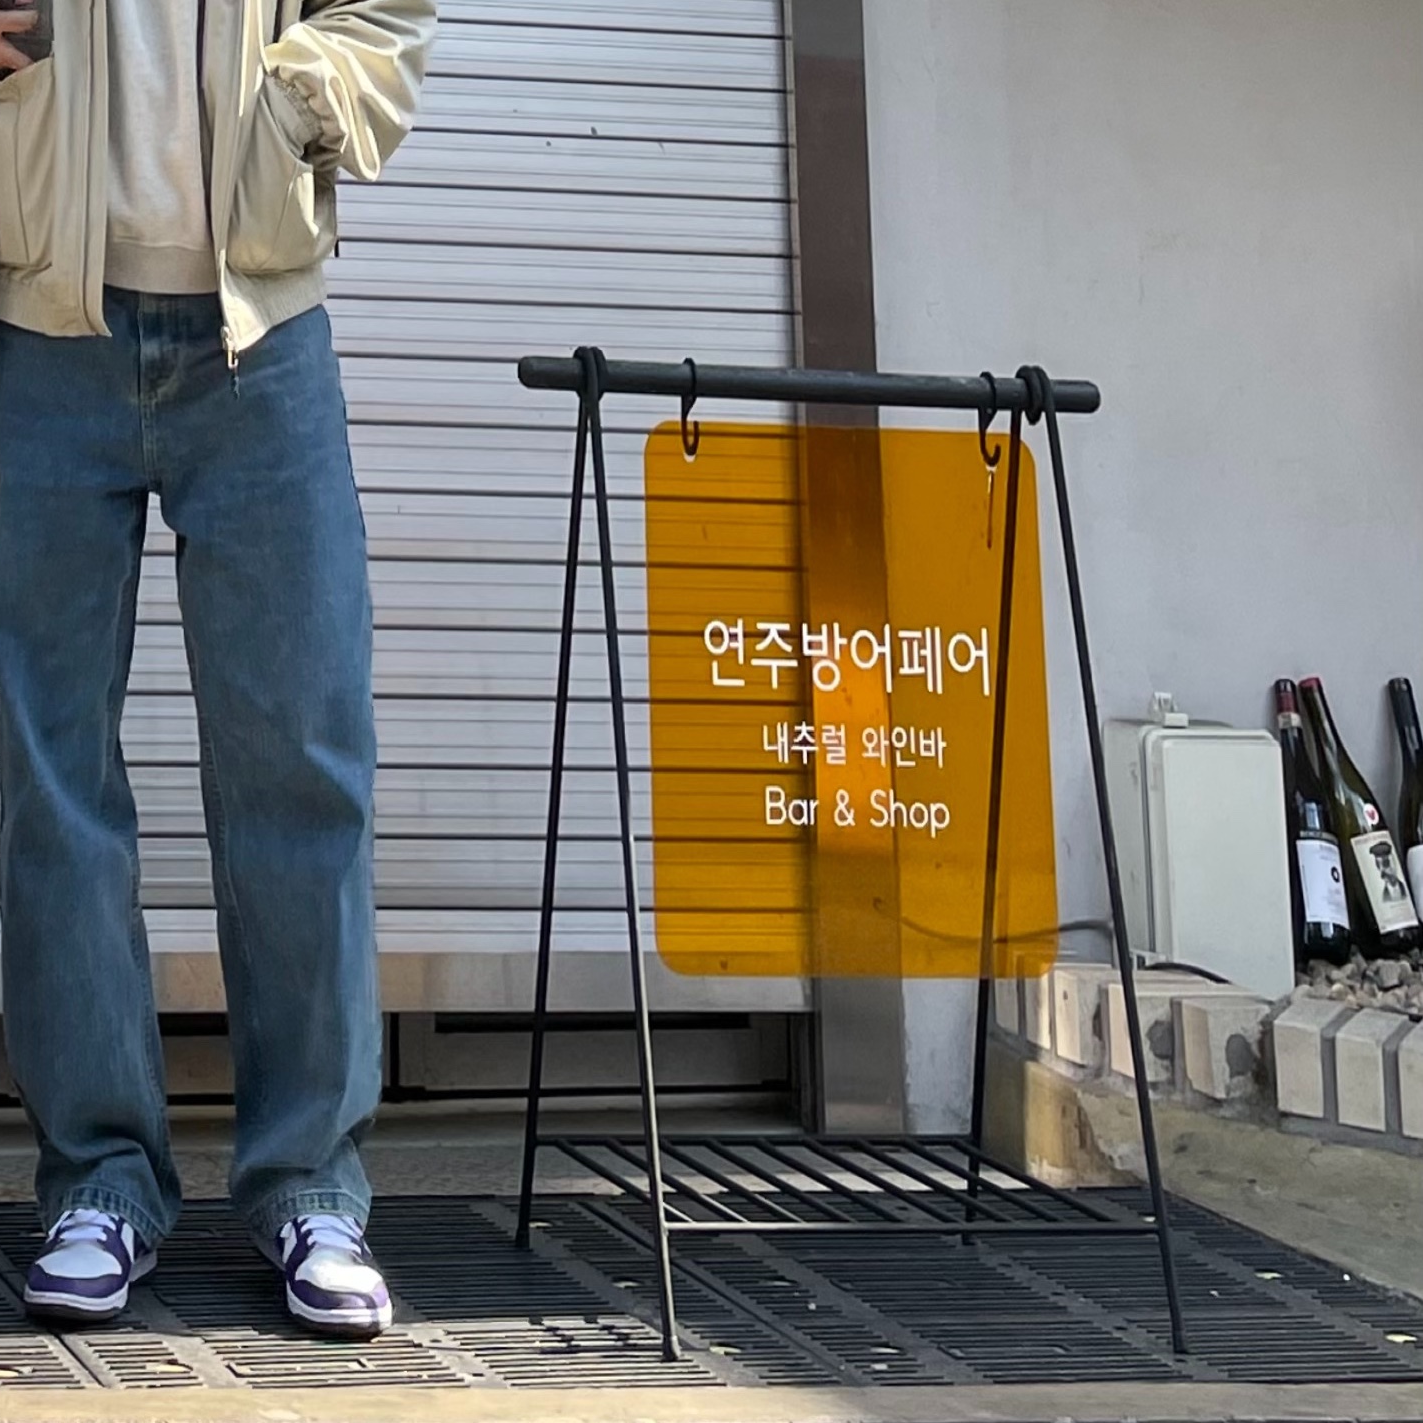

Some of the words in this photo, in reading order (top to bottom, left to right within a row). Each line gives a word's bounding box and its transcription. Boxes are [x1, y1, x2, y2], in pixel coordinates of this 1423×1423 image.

[704, 618, 990, 695] 연주방어페어
[763, 721, 846, 765] 내추럴
[861, 726, 947, 767] 와인바
[765, 786, 818, 824] Bar
[834, 789, 855, 826] &
[870, 788, 950, 837] Shop
